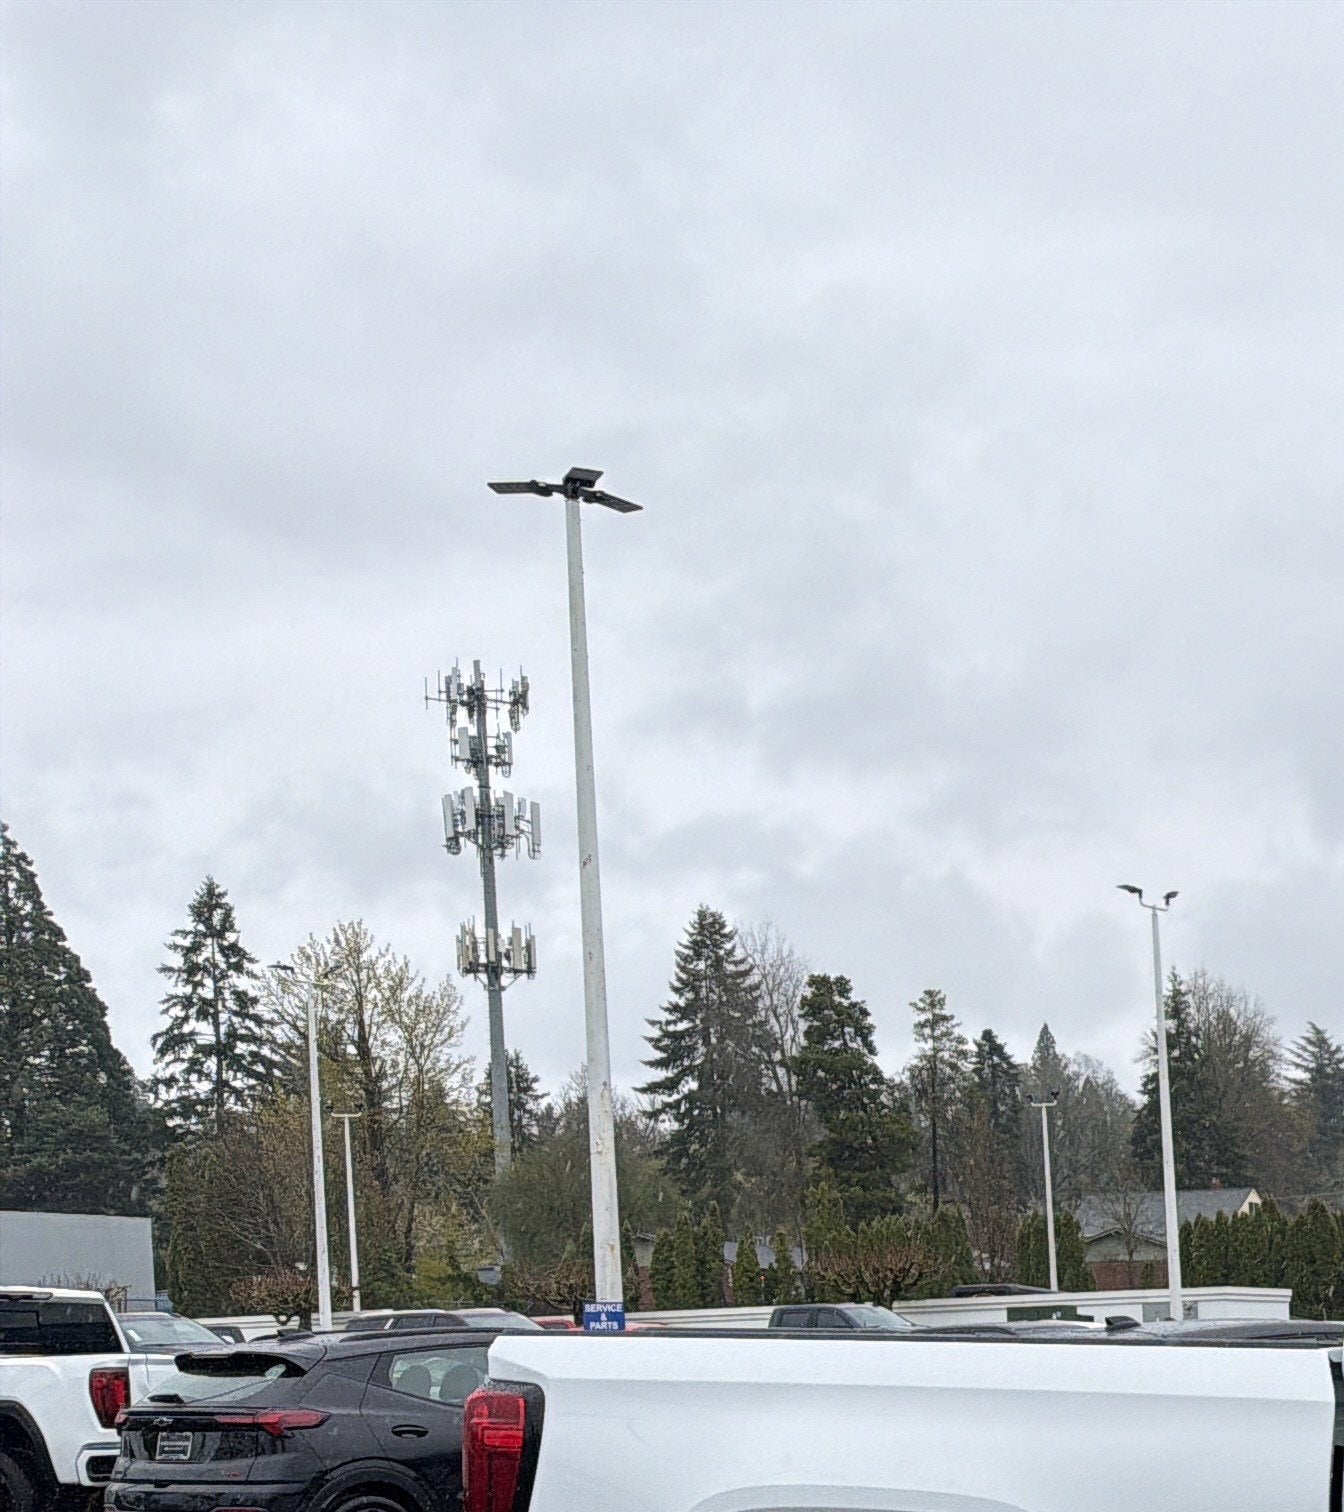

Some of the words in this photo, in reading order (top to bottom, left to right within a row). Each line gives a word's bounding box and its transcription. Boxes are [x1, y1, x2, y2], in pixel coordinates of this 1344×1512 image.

[585, 1303, 624, 1313] SERVICE
[600, 1312, 607, 1321] &
[590, 1321, 619, 1330] PARTS
